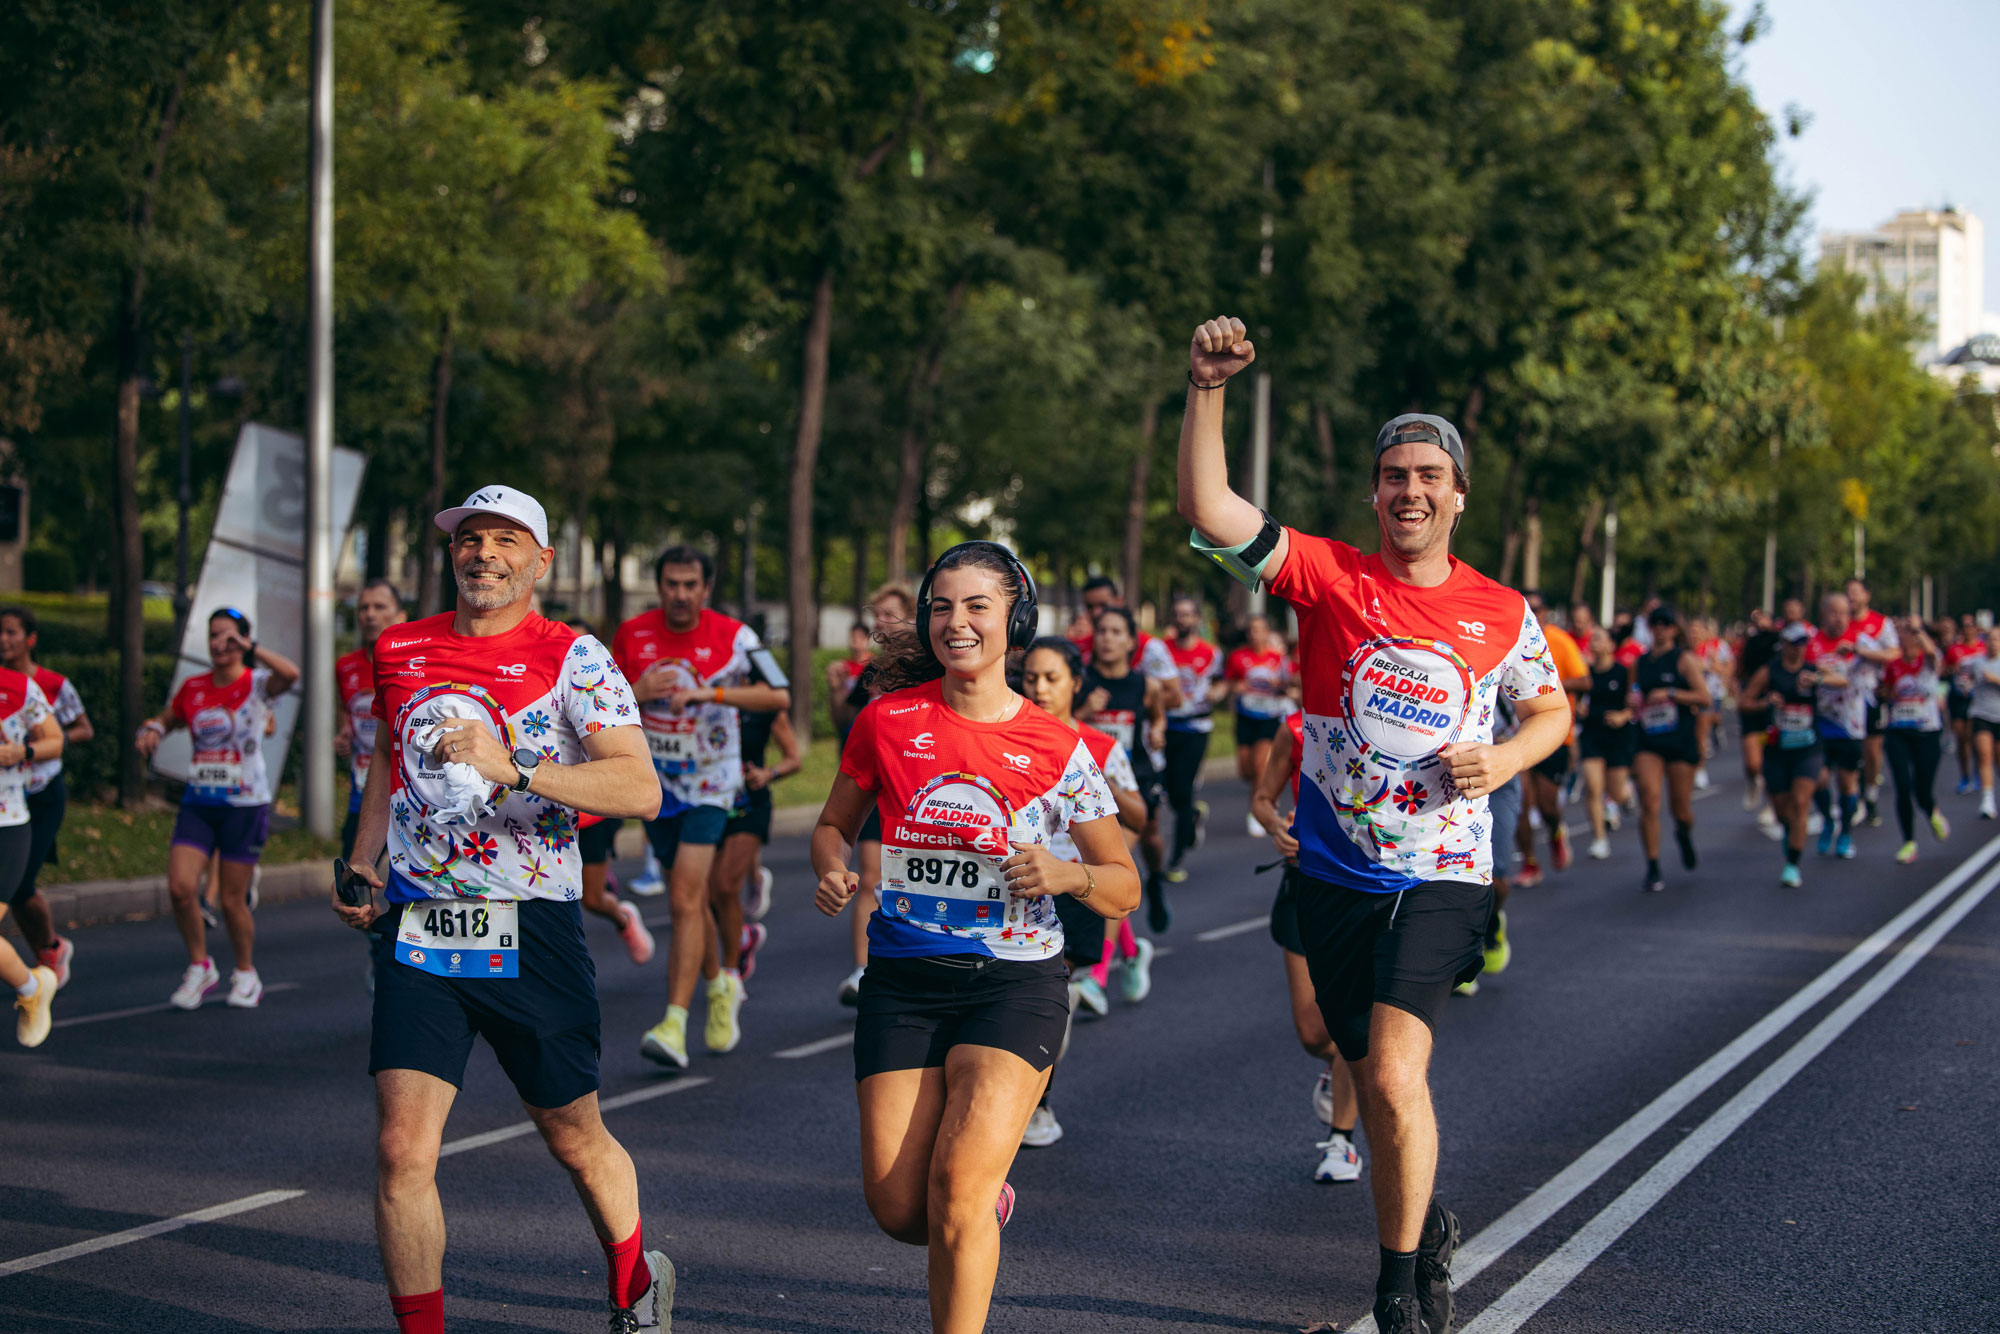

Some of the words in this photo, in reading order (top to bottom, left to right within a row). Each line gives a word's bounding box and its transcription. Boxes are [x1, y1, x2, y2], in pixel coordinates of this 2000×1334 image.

[397, 670, 426, 679] Ibercaja
[1372, 658, 1429, 683] IBERCAJA
[1361, 667, 1449, 704] MADRID
[1375, 687, 1403, 700] CORRE
[1403, 696, 1421, 706] POR
[889, 704, 918, 716] luanvi
[1366, 693, 1451, 729] MADRID
[410, 718, 437, 727] IBER
[903, 750, 935, 761] Ibercaja
[926, 799, 974, 811] IBERCAJA
[920, 806, 992, 826] MADRID
[932, 820, 955, 828] CORRE
[895, 826, 963, 846] Ibercaja
[906, 857, 979, 889] 8978
[991, 888, 997, 897] 8
[424, 908, 489, 938] 4618
[503, 936, 509, 946] 6
